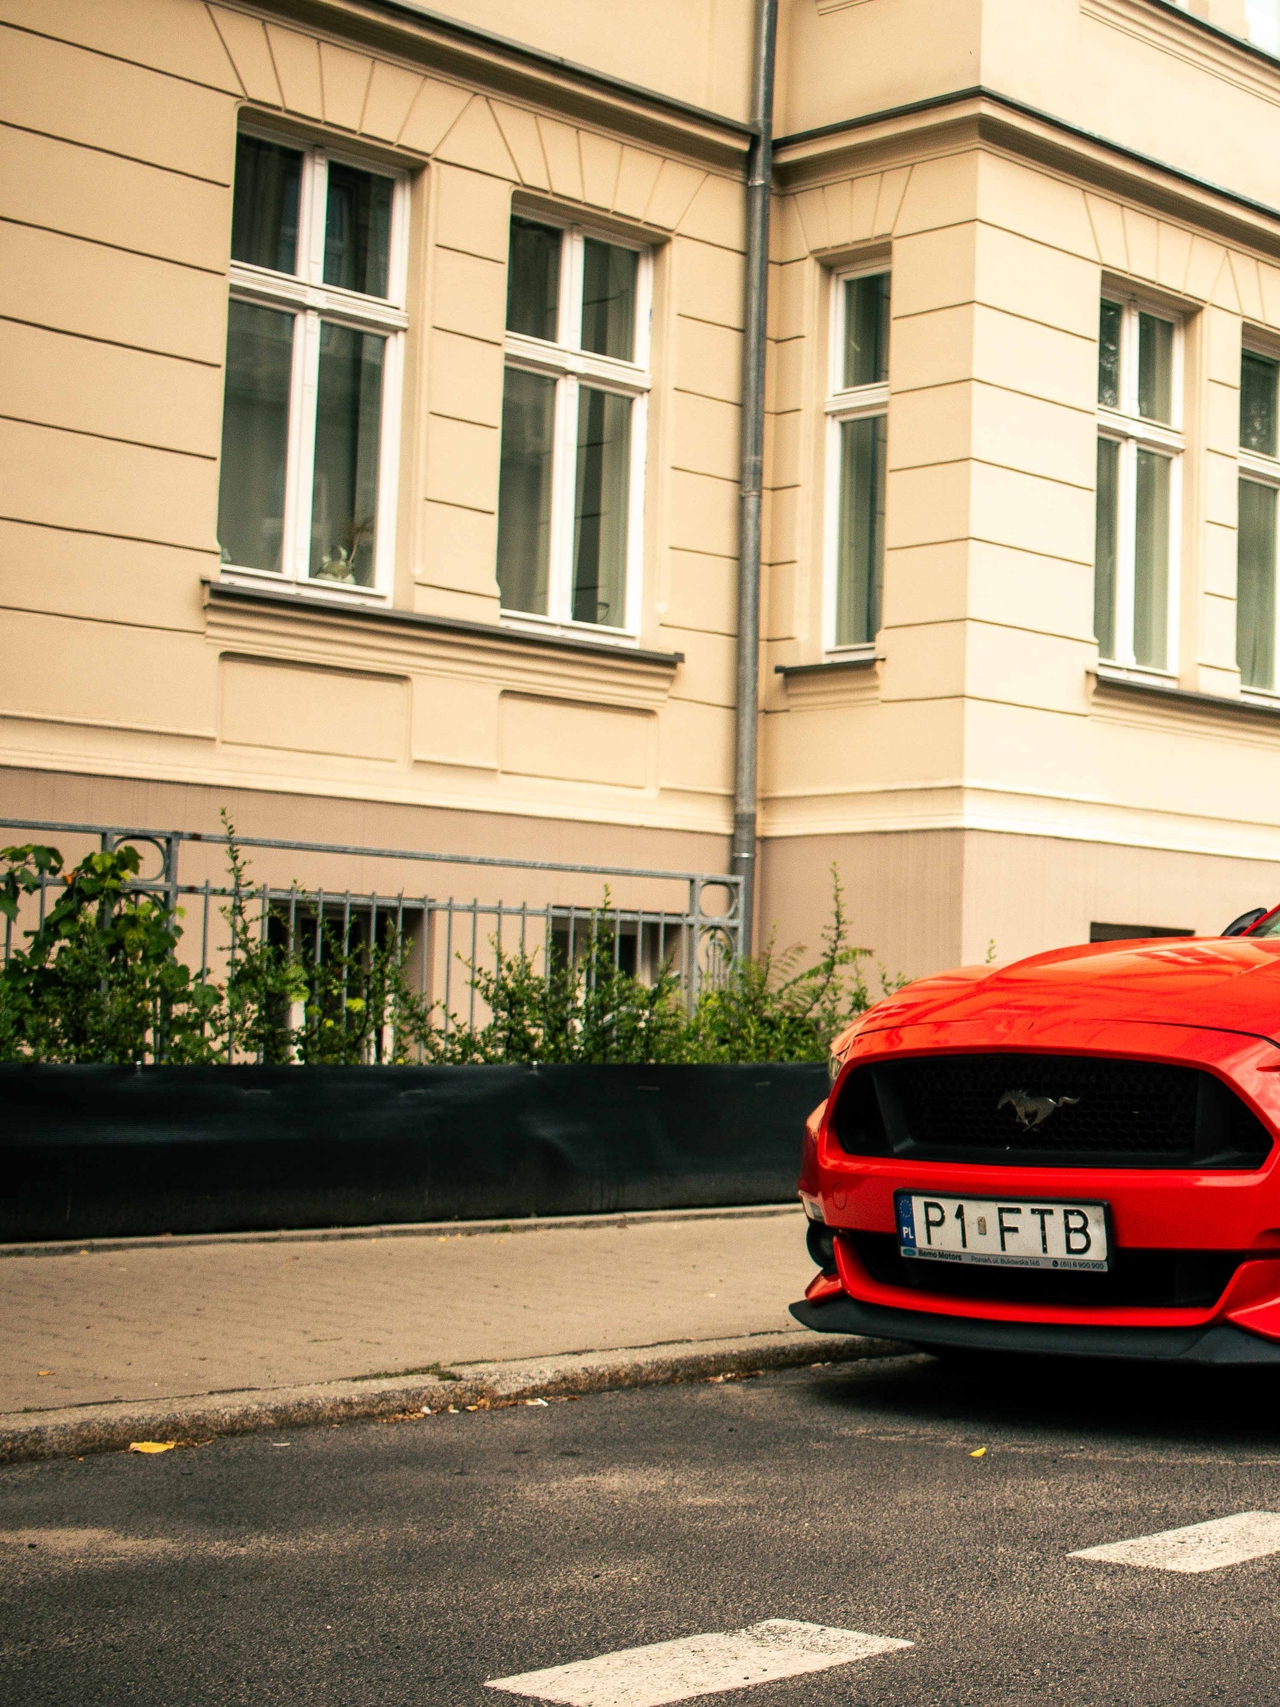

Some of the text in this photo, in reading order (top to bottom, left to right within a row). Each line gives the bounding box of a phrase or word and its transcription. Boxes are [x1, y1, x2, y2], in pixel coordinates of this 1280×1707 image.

[903, 1226, 914, 1239] PL
[924, 1201, 1092, 1255] P1 FTB
[938, 1251, 962, 1261] Motors
